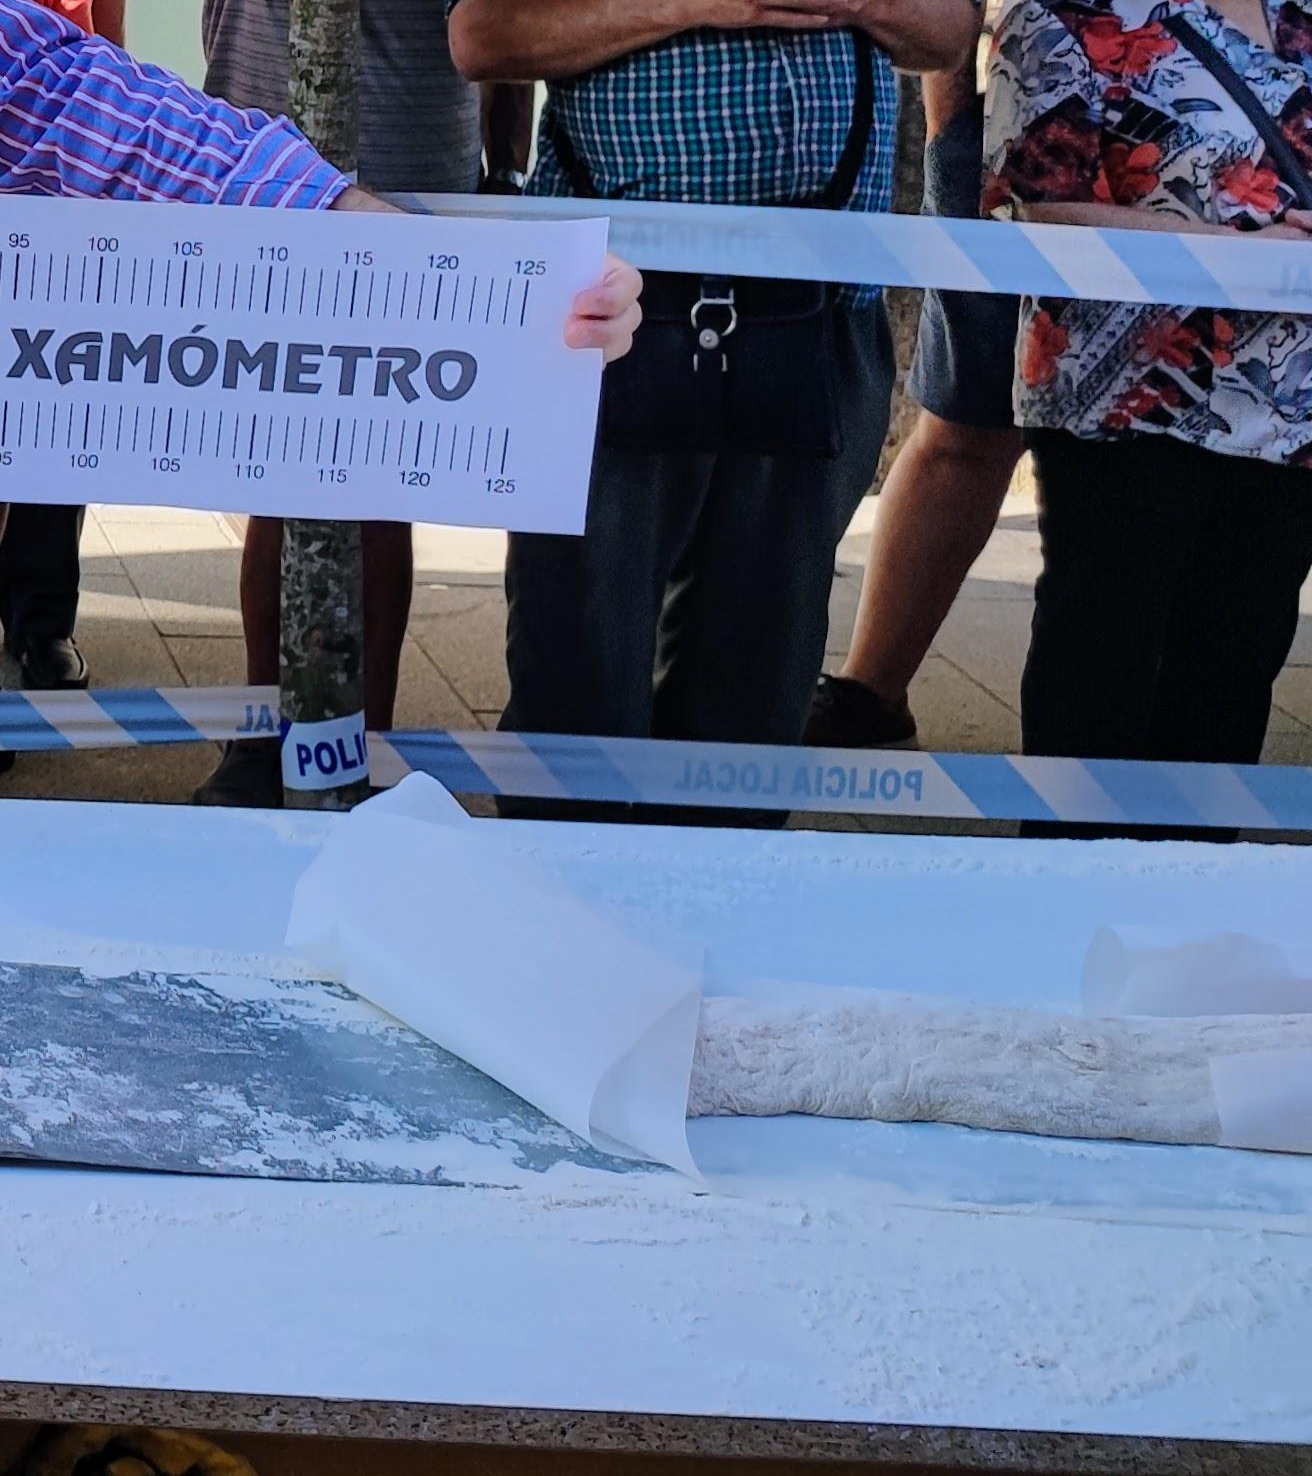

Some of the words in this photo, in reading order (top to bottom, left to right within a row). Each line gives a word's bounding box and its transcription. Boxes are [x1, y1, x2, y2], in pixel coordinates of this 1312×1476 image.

[8, 232, 30, 249] 95
[88, 236, 119, 253] 100
[172, 240, 203, 257] 105
[257, 245, 289, 262] 110
[343, 250, 374, 267] 115
[427, 253, 460, 270] 120
[514, 259, 547, 276] 125
[5, 324, 478, 405] XAMÓMETRO
[71, 453, 99, 469] 100
[152, 457, 181, 473] 105
[236, 463, 265, 480] 110
[319, 467, 347, 484] 115
[399, 470, 431, 488] 120
[485, 478, 516, 494] 125
[295, 733, 368, 778] POLI
